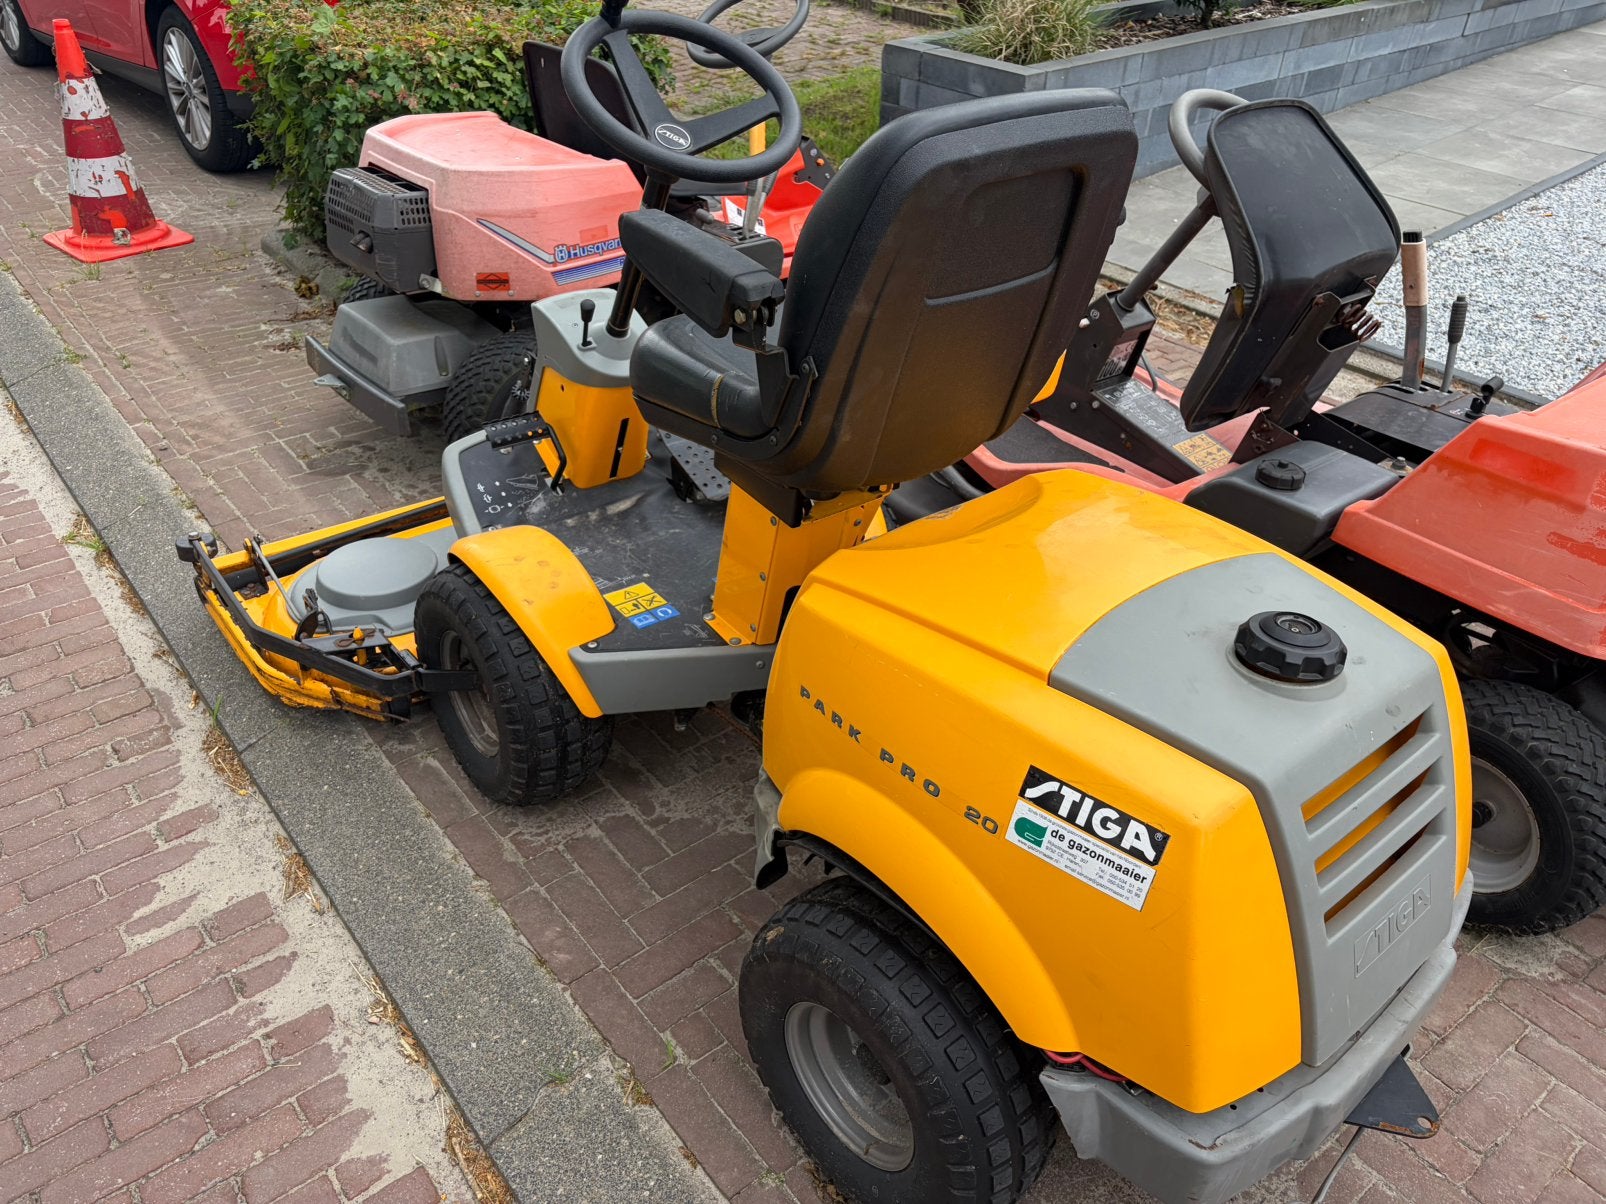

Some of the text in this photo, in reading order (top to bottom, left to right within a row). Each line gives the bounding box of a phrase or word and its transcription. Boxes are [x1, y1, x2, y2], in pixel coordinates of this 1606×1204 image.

[657, 129, 687, 146] STIGA
[799, 684, 999, 835] PARK PRO 20
[1024, 780, 1157, 862] STIGA
[1049, 826, 1148, 888] de gazonmaaier
[1356, 887, 1431, 974] STIGA
